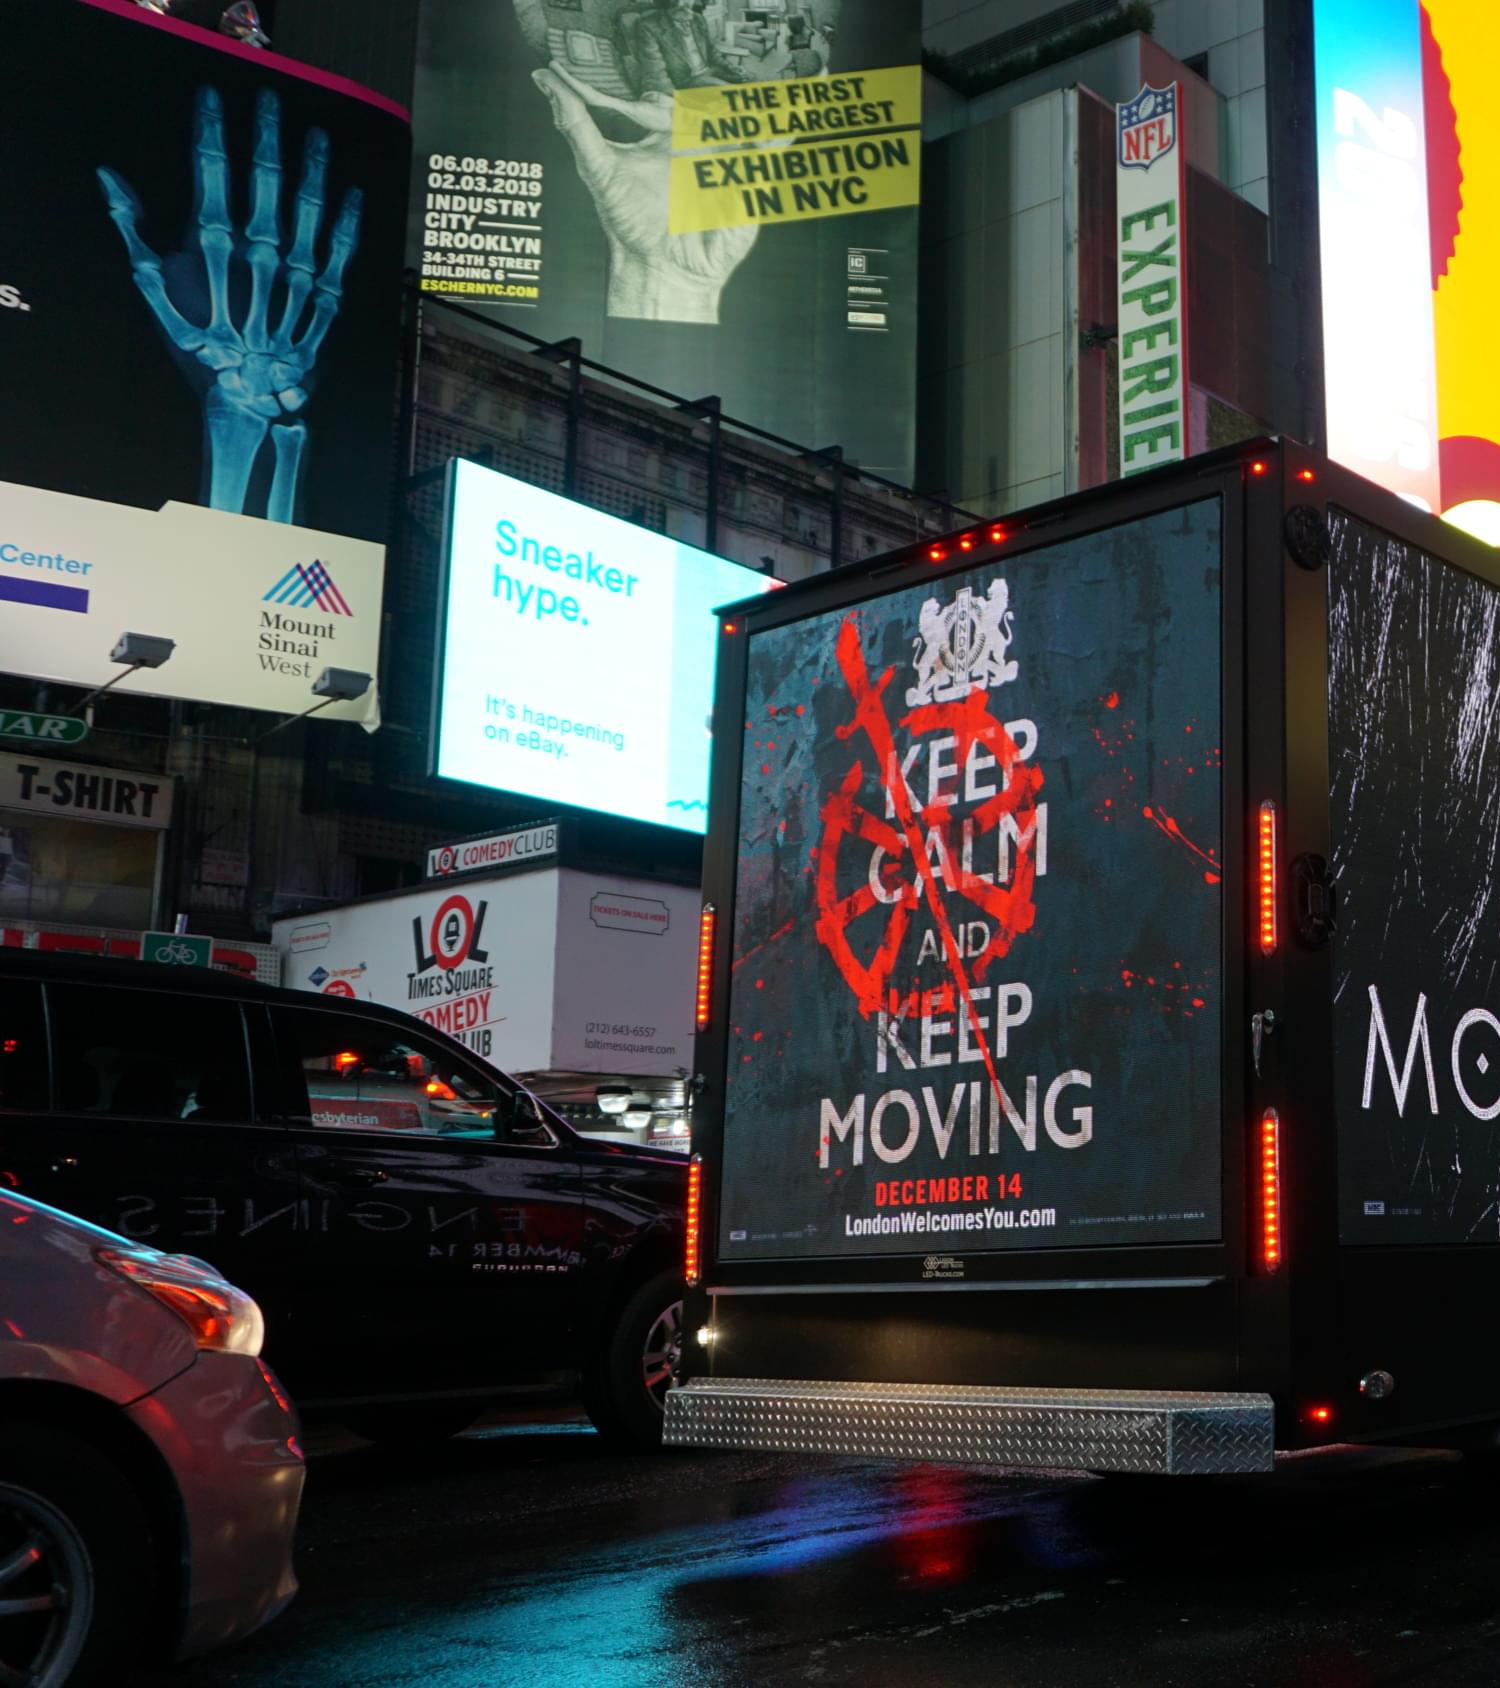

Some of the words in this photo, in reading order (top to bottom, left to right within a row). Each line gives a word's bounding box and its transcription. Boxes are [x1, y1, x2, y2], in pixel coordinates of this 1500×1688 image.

[721, 86, 780, 112] THE
[785, 77, 865, 106] FIRST
[701, 115, 761, 142] AND
[769, 101, 894, 135] LARGEST
[1123, 117, 1171, 161] NFL
[429, 154, 543, 178] 06.08.2018
[693, 138, 910, 188] EXHIBITION
[428, 173, 542, 197] 02.03.2019
[741, 186, 784, 217] IN
[791, 176, 868, 212] NYC
[425, 212, 476, 231] CITY
[426, 193, 542, 218] INDUSTRY
[424, 230, 541, 254] BROOKLYN
[422, 264, 491, 280] BUILDING
[494, 270, 505, 281] 6
[423, 251, 484, 266] 34-34TH
[488, 256, 542, 271] STREET
[421, 279, 539, 298] ESCHERNYC.COM
[1121, 199, 1180, 478] EXPERIE
[0, 543, 93, 576] Center
[495, 519, 640, 597] Sneaker
[492, 563, 590, 627] hype.
[259, 611, 336, 640] Mount
[258, 633, 318, 658] Sinai
[256, 653, 312, 678] West
[0, 713, 67, 740] AR
[485, 694, 517, 720] It's
[522, 701, 625, 752] happening
[484, 724, 510, 743] on
[516, 730, 570, 760] eBay.
[885, 718, 1038, 819] KEEP
[16, 764, 159, 818] T-SHIRT
[868, 802, 1048, 904] CALM
[412, 895, 488, 974] LOL
[916, 920, 991, 966] AND
[407, 971, 442, 1000] TIMES
[445, 966, 494, 997] SQUARE
[415, 992, 491, 1033] OMEDY
[585, 1022, 610, 1035] (212)
[875, 981, 1034, 1074] KEEP
[584, 1038, 676, 1054] loltimessquare.com
[312, 1111, 378, 1125] esbyterian
[818, 1069, 1094, 1169] MOVING
[874, 1176, 989, 1207] DECEMBER
[998, 1173, 1023, 1199] 14
[844, 1207, 1057, 1237] LondonWelcomesYou.com
